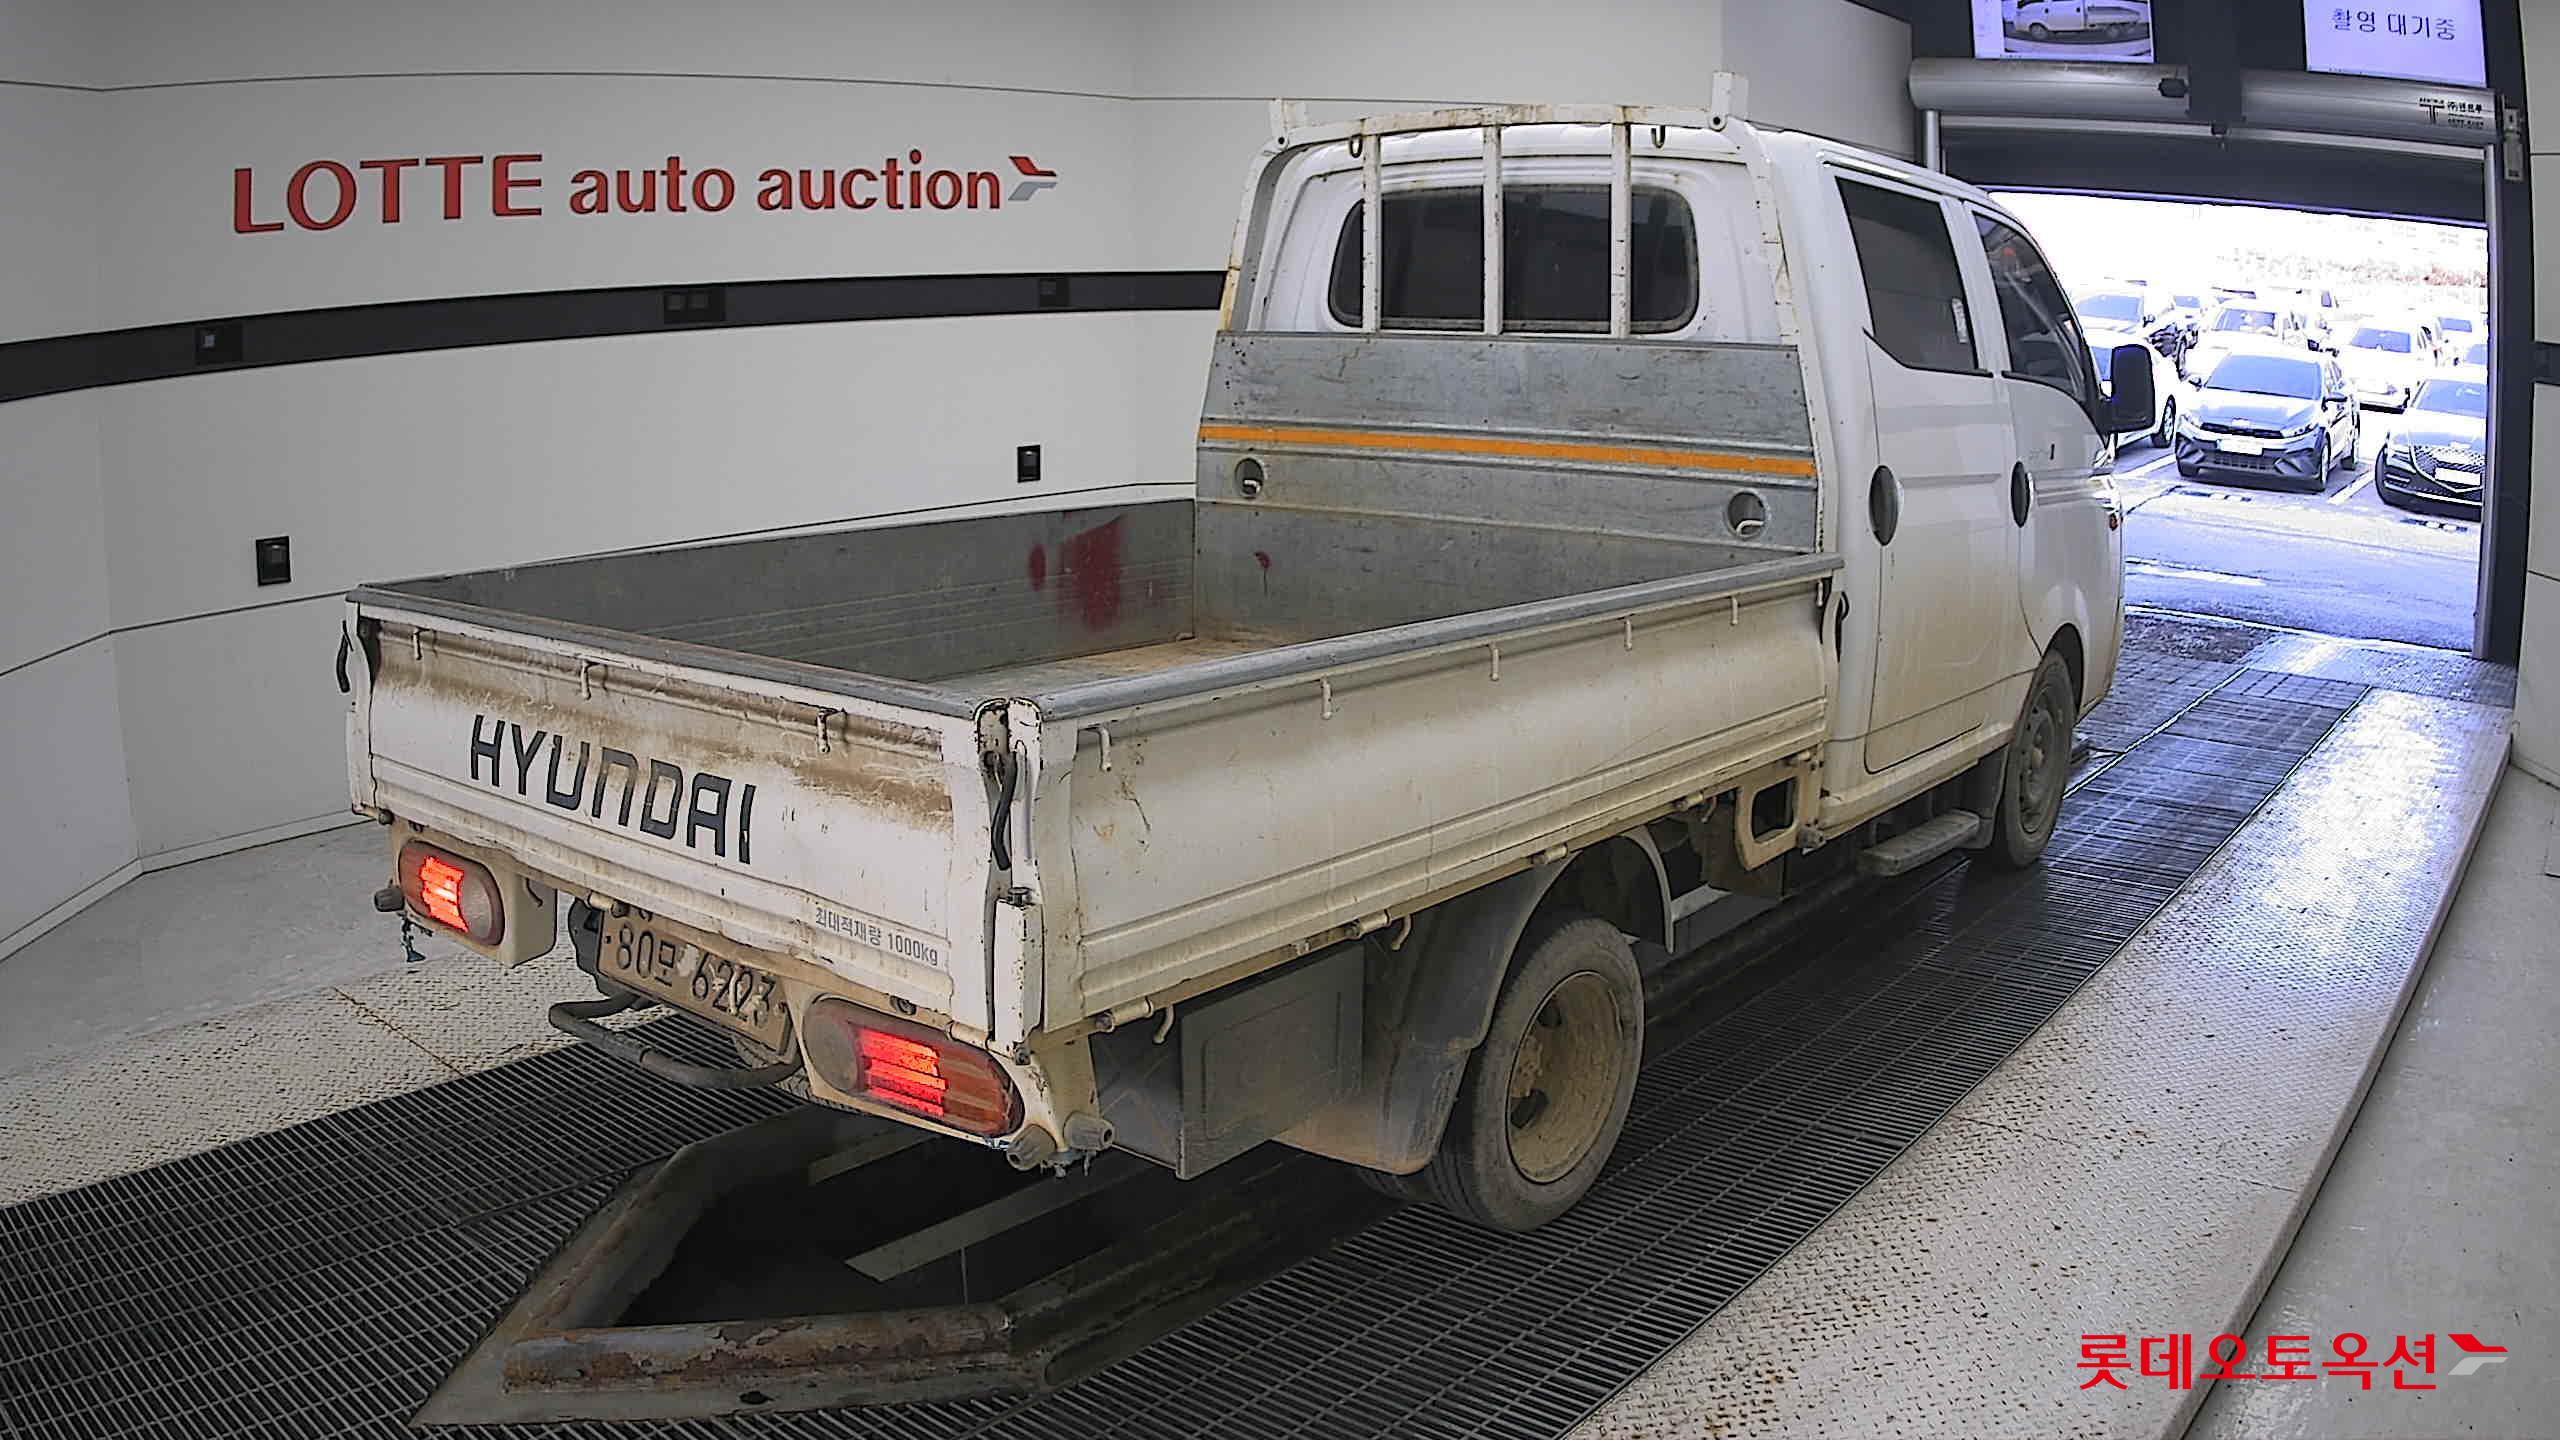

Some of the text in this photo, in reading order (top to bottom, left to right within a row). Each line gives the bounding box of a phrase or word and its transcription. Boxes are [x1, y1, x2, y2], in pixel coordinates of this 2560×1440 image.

[2386, 13, 2456, 41] 대기중
[233, 149, 1001, 234] LOTTE auto auction
[469, 714, 756, 865] HYUNDAI
[616, 922, 677, 987] 80모
[815, 906, 881, 946] 최대적재량
